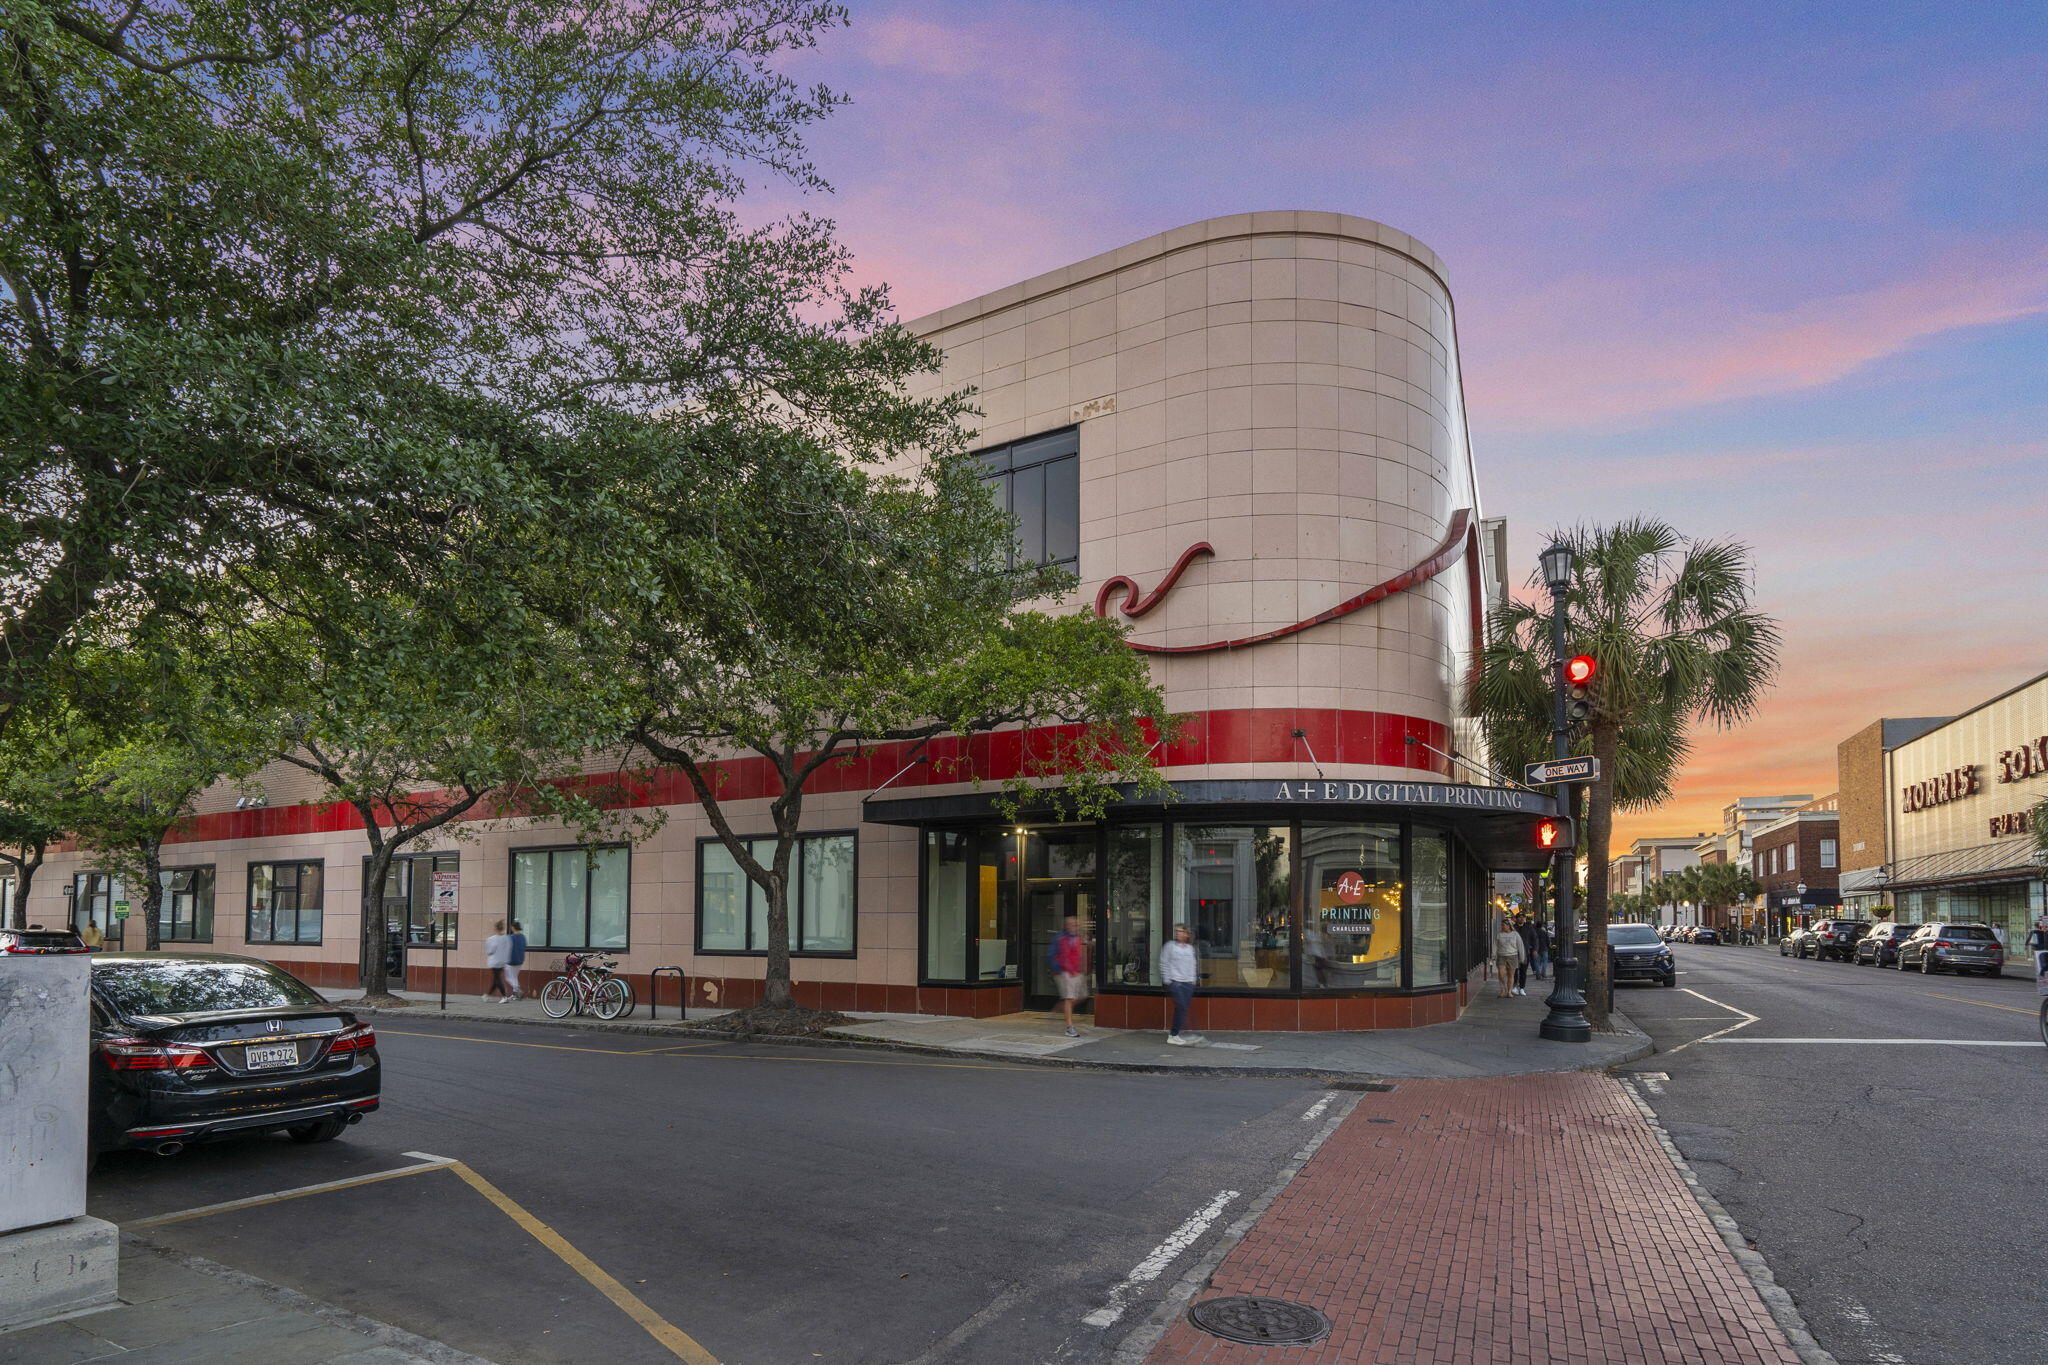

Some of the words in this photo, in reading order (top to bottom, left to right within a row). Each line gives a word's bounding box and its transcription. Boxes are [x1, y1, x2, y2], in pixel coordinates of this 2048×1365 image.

[1545, 766, 1564, 776] ONE
[1566, 763, 1586, 773] WAY
[1902, 765, 1975, 813] MORRIS
[1995, 735, 2048, 784] SOK
[1275, 782, 1293, 800] A
[1323, 782, 1339, 800] E
[1347, 782, 1439, 803] DIGITAL
[1444, 786, 1522, 809] PRINTING
[1989, 803, 2039, 837] FURN
[1338, 878, 1364, 896] A+E
[1321, 908, 1381, 920] PRINTING
[276, 1048, 294, 1060] 972
